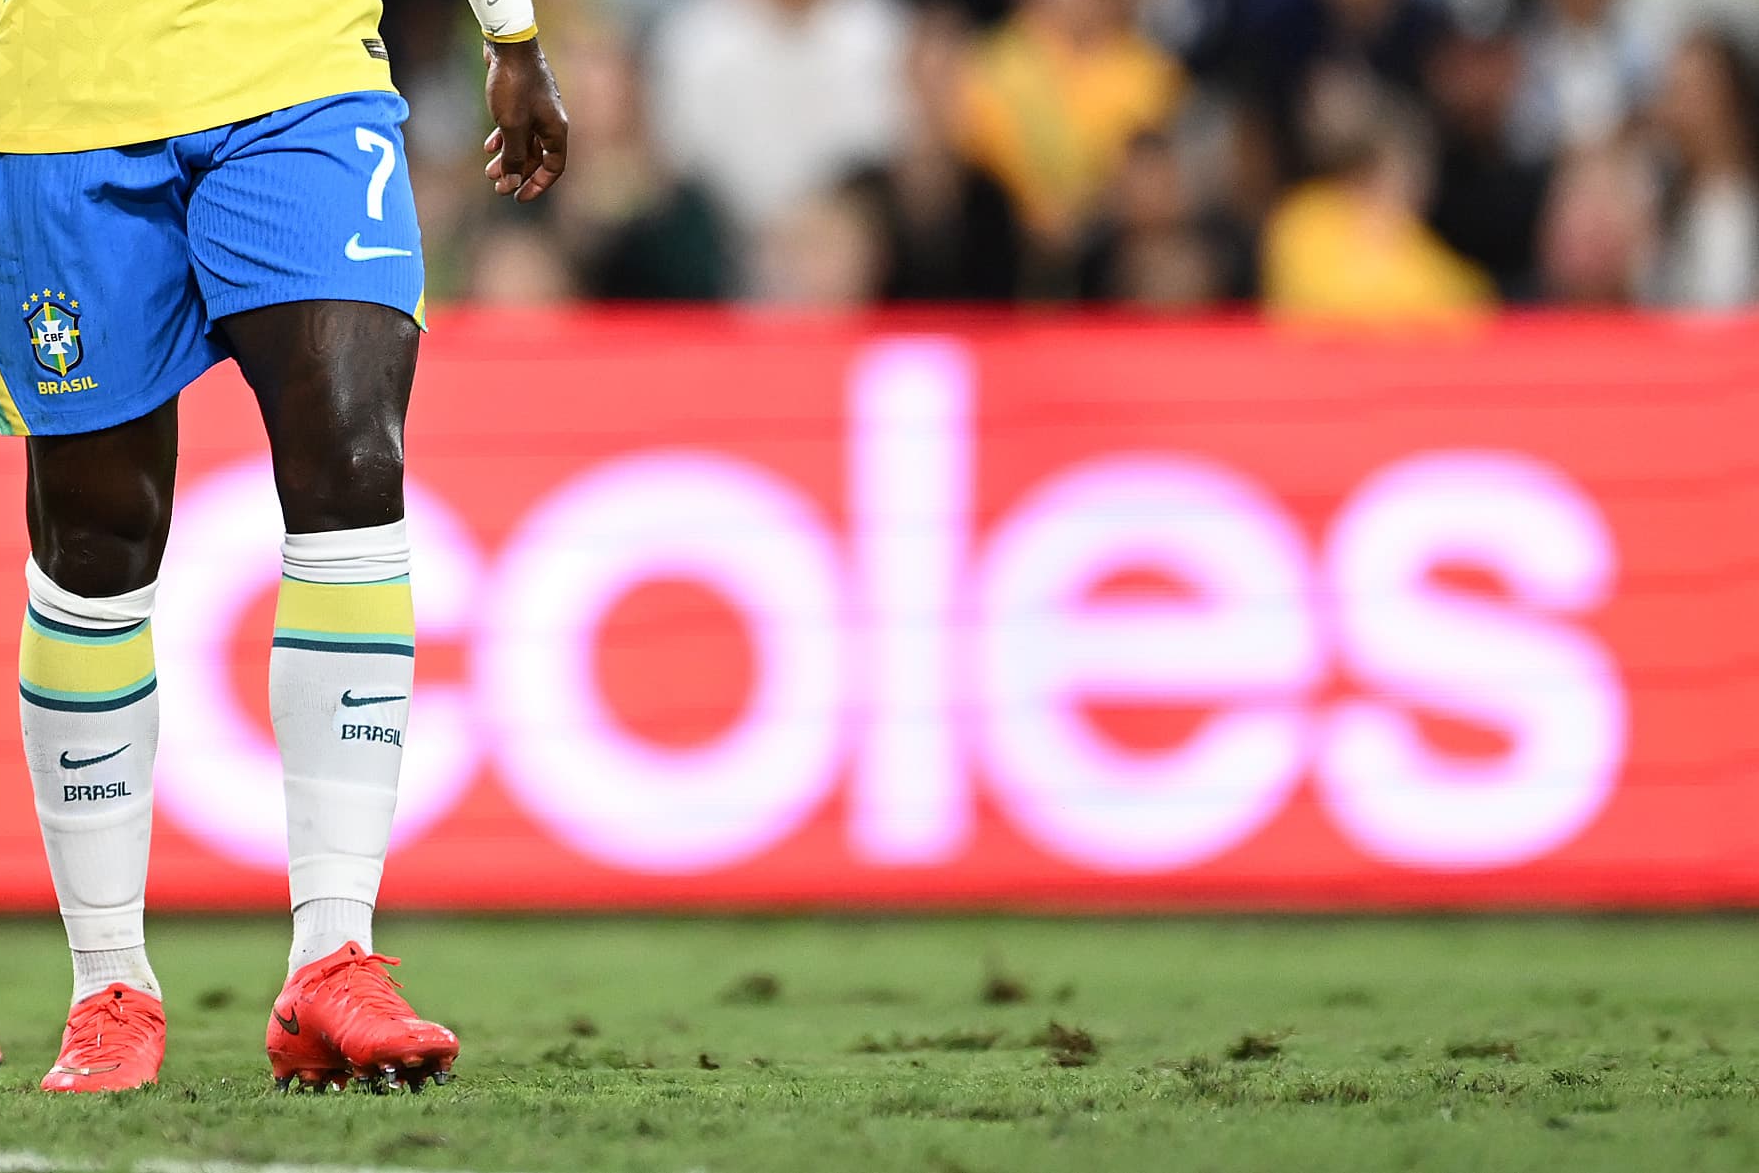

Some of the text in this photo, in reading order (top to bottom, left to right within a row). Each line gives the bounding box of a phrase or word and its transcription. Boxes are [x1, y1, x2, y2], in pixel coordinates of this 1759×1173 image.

[355, 126, 396, 221] 7
[43, 332, 64, 343] CBF
[37, 375, 98, 395] BRASIL
[146, 336, 1629, 878] coles
[341, 723, 403, 749] BRASIL
[63, 781, 132, 803] BRASIL
